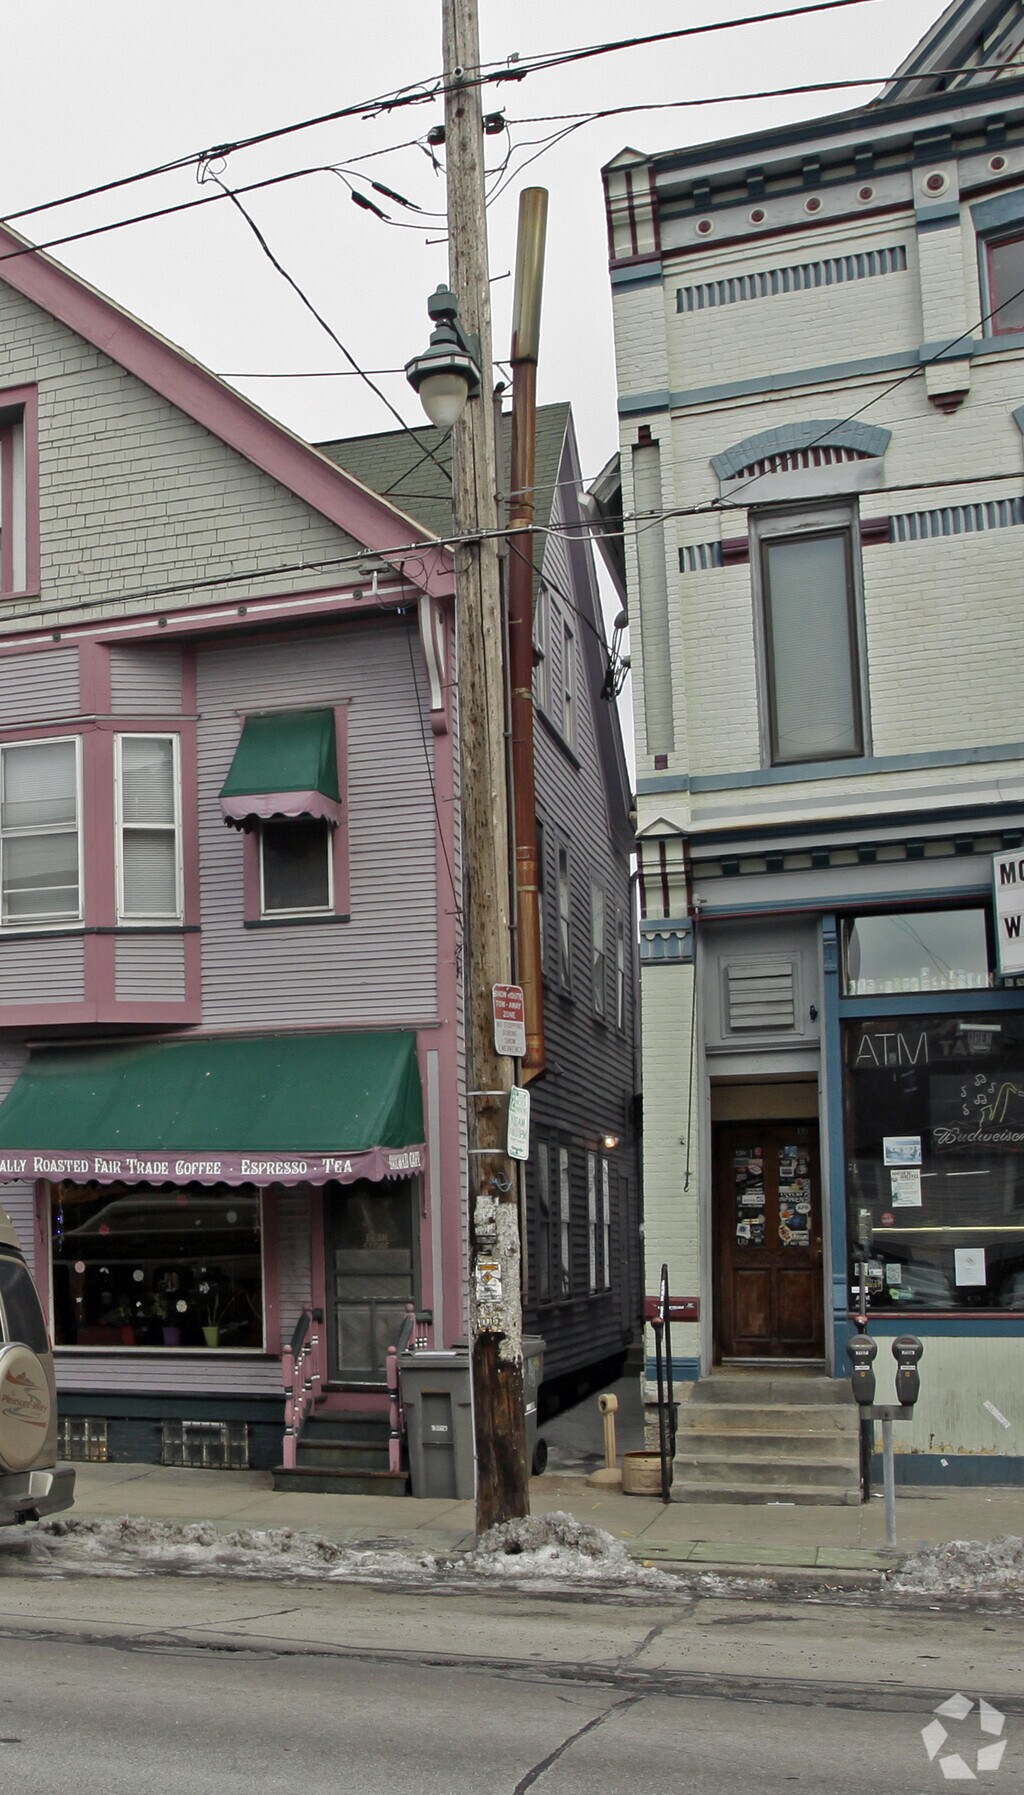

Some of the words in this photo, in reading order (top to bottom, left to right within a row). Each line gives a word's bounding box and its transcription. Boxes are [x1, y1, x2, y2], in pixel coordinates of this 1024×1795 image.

[1004, 915, 1021, 938] W
[502, 1010, 516, 1018] ZONE
[855, 1031, 929, 1066] ATM
[33, 1156, 89, 1173] ROASTED
[94, 1157, 122, 1174] FAIR
[126, 1158, 169, 1175] TRADE
[175, 1160, 222, 1175] COFFEE
[241, 1159, 308, 1175] ESPRESSO
[322, 1158, 353, 1174] TEA
